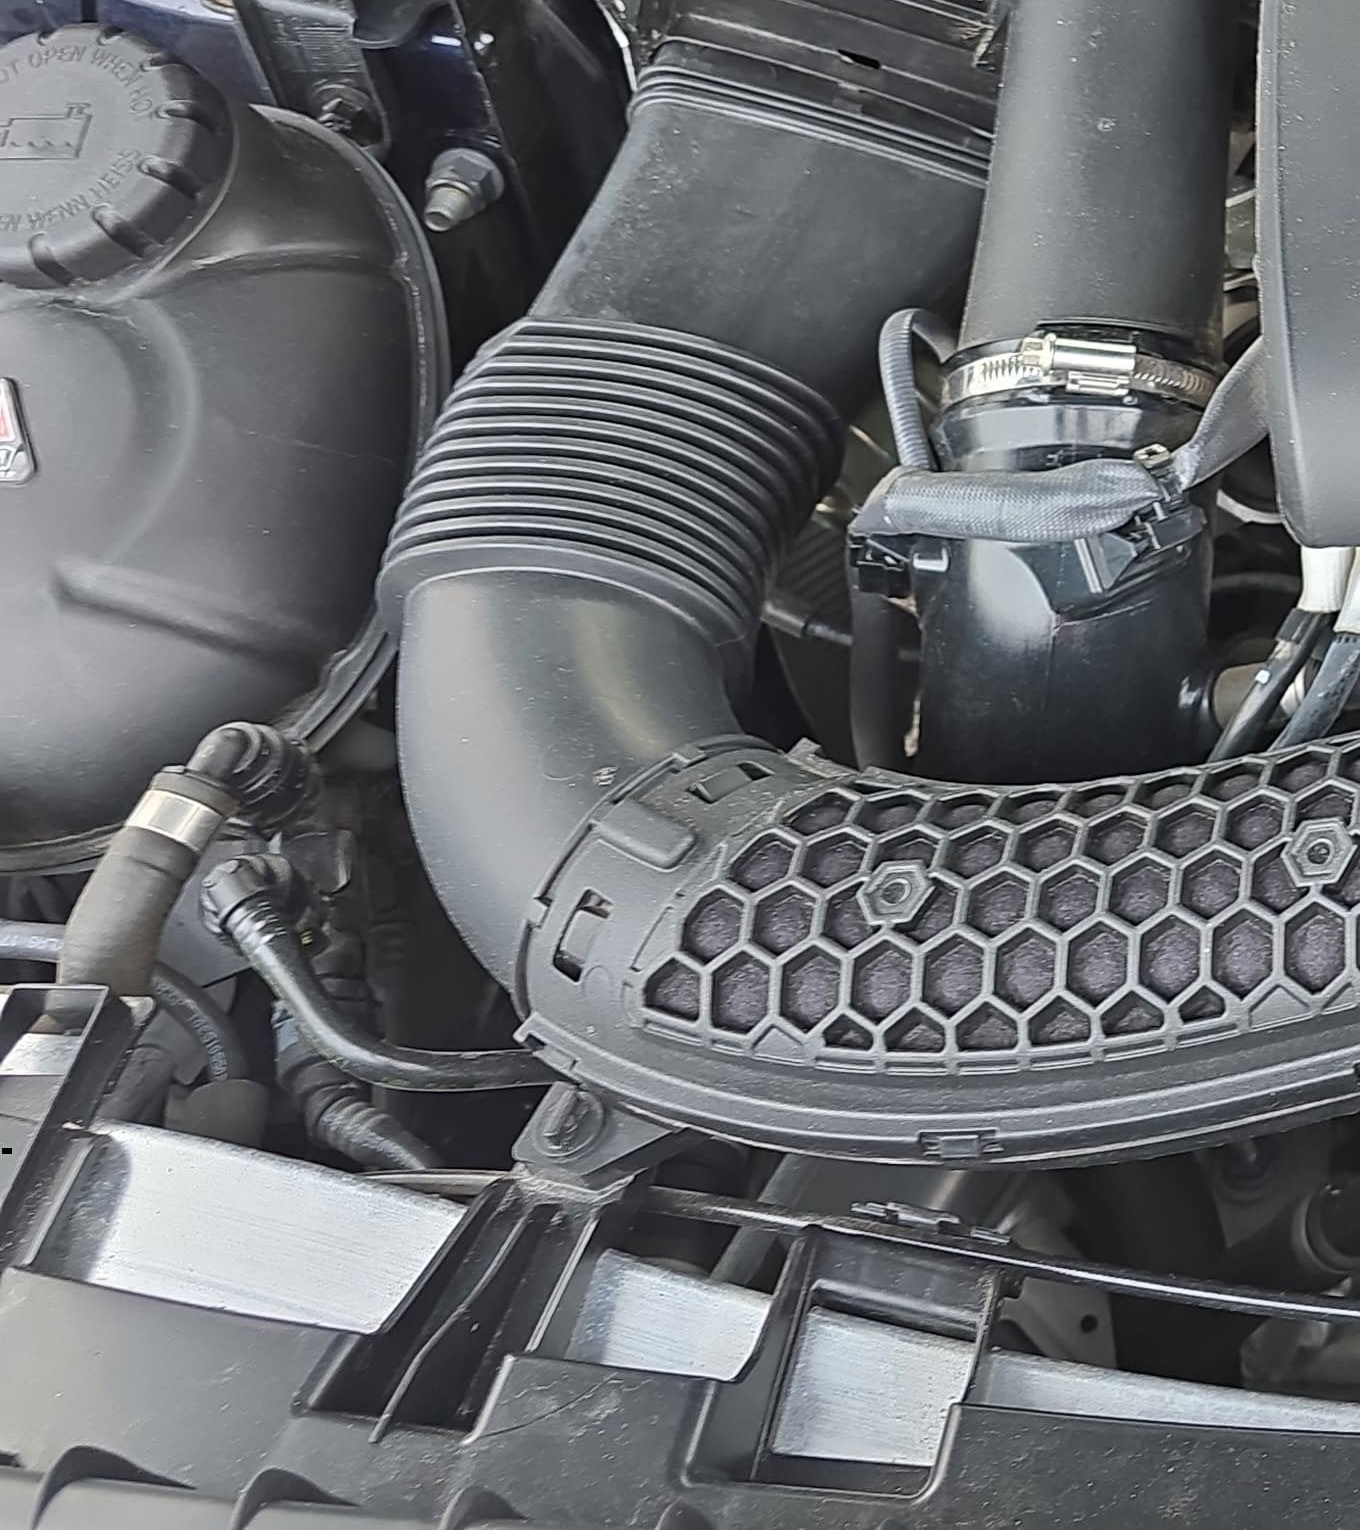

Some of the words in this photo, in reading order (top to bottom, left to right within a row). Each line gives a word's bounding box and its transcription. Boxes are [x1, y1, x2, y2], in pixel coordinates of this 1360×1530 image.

[0, 60, 20, 84] OT
[28, 45, 88, 69] OPEN
[90, 47, 145, 87] WHEN
[26, 193, 92, 231] WENN
[88, 148, 141, 200] HEISS
